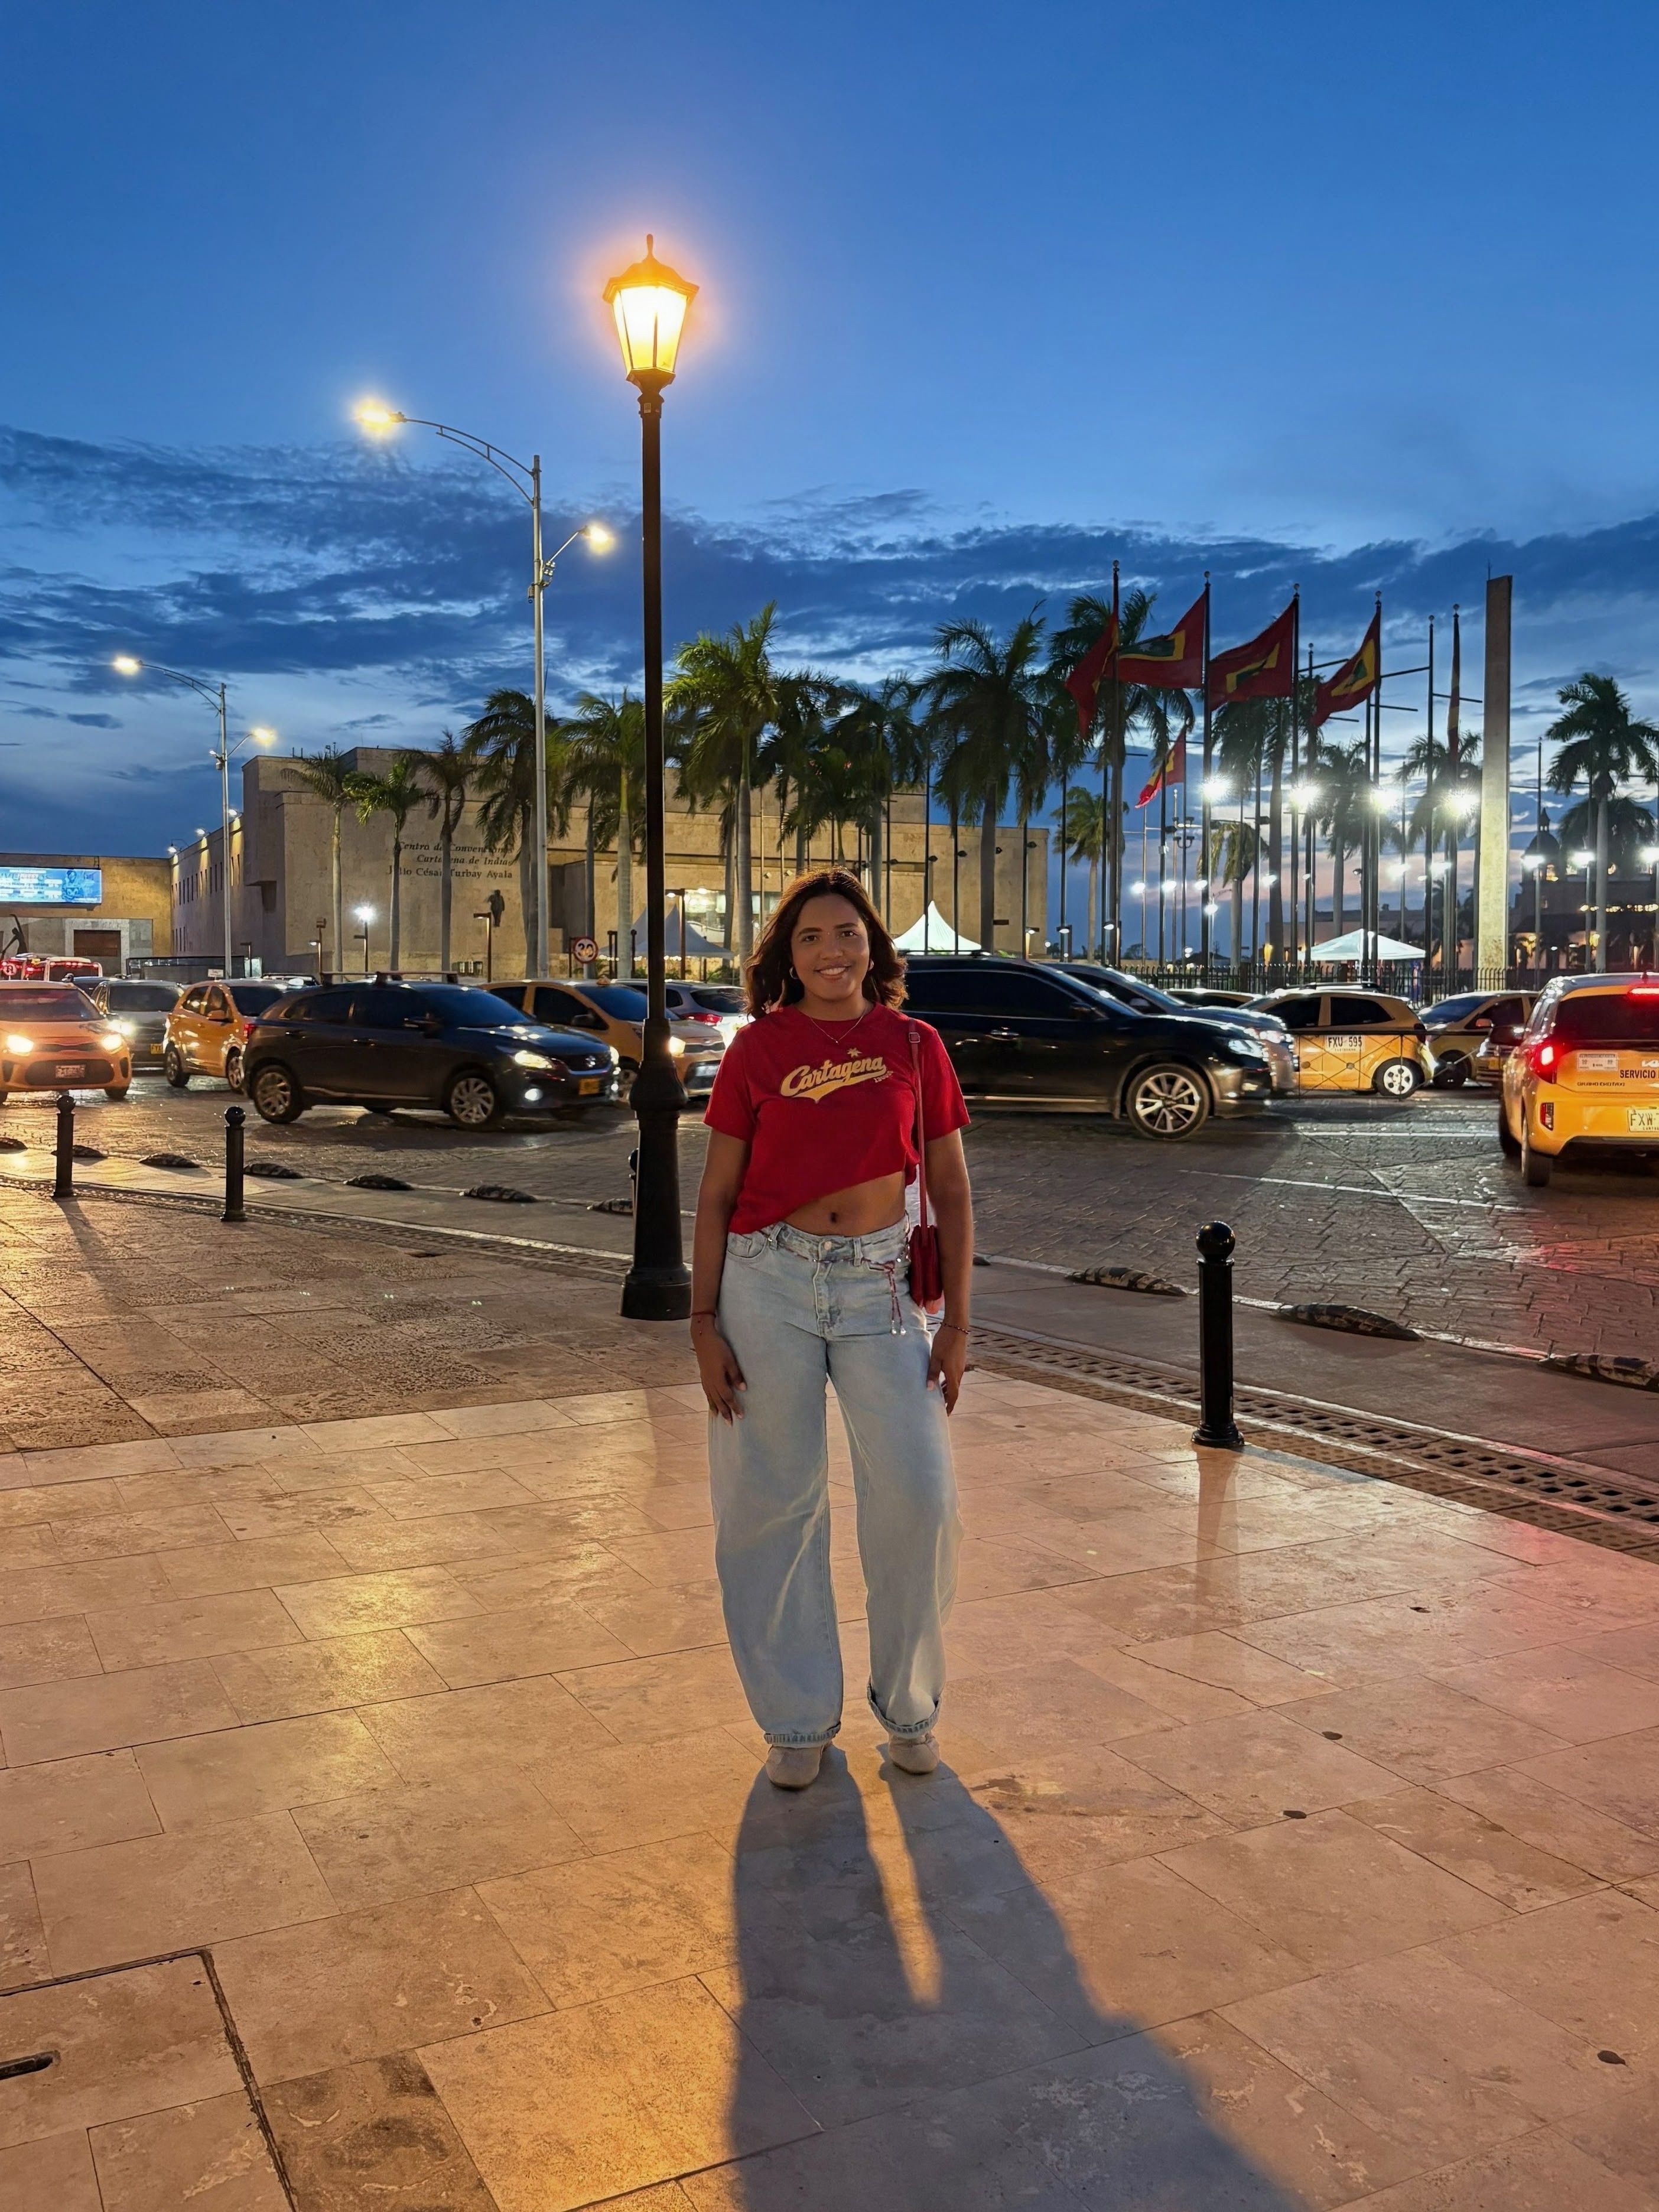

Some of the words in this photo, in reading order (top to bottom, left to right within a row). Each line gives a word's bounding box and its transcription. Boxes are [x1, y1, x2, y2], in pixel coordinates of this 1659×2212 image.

[400, 841, 430, 851] Centro
[469, 856, 480, 864] de
[386, 865, 412, 876] Jlio
[450, 868, 482, 879] Turbay
[486, 870, 512, 879] Ayala
[578, 943, 594, 957] 30
[1328, 1036, 1343, 1048] FXU
[1348, 1036, 1362, 1048] 595
[780, 1057, 885, 1097] Cartagena
[1619, 1069, 1656, 1079] SERVICIO
